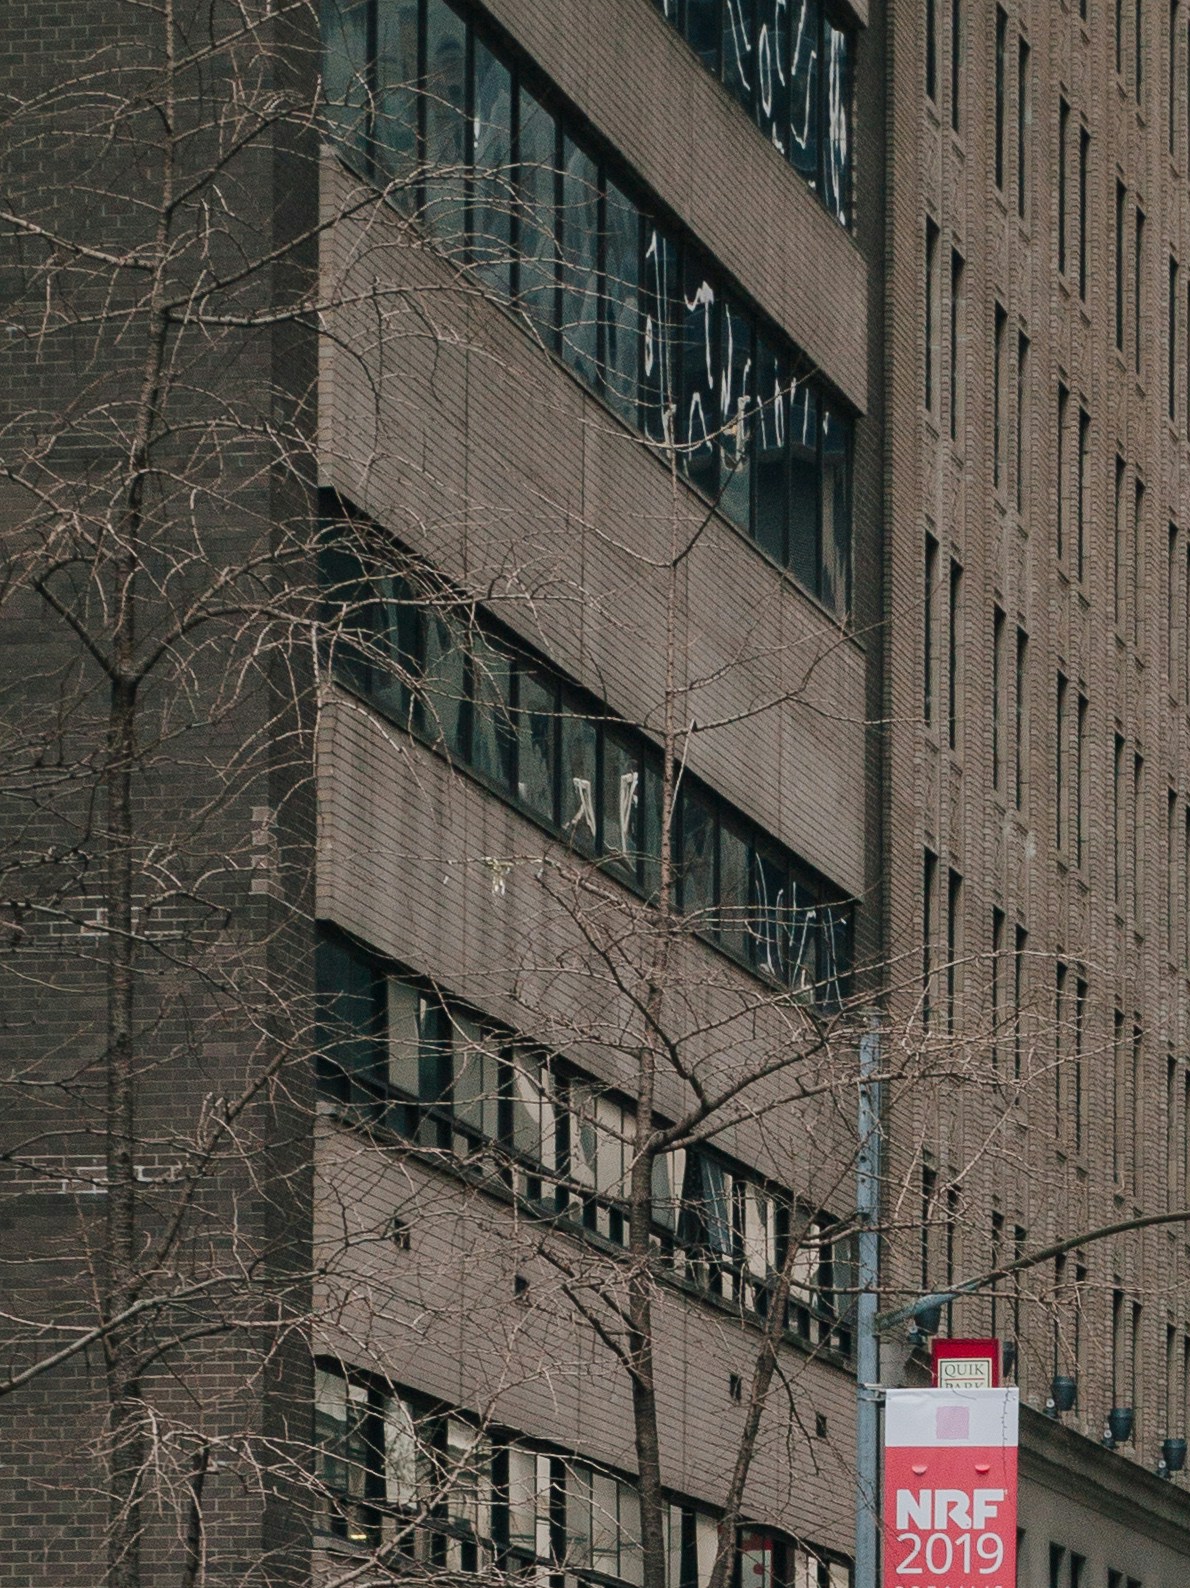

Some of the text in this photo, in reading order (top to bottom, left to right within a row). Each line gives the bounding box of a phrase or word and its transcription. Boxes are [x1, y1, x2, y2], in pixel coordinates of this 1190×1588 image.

[944, 1363, 985, 1379] QUIK
[895, 1488, 1004, 1531] NRF
[895, 1532, 1004, 1575] 2019
